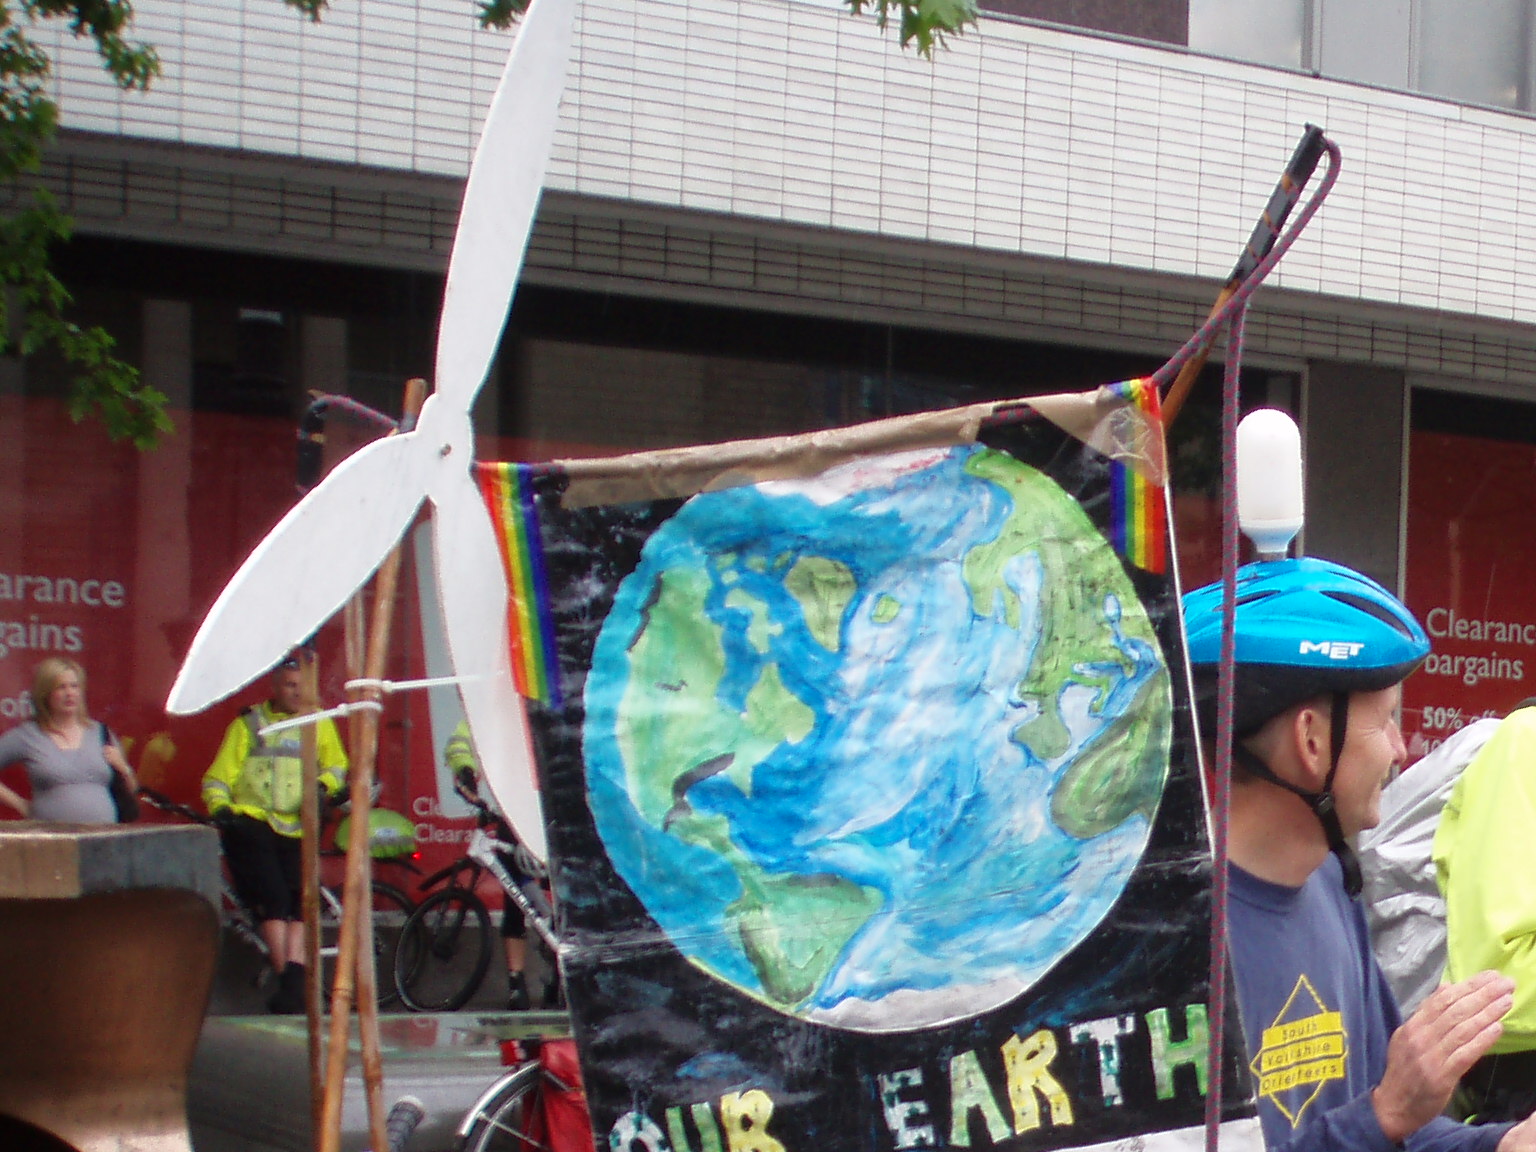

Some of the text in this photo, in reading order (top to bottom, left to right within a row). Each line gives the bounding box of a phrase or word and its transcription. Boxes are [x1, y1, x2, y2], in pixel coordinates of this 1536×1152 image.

[1299, 641, 1365, 660] MET
[1424, 651, 1524, 686] bargains
[1422, 706, 1464, 730] 50%
[878, 1003, 1209, 1150] EARTH
